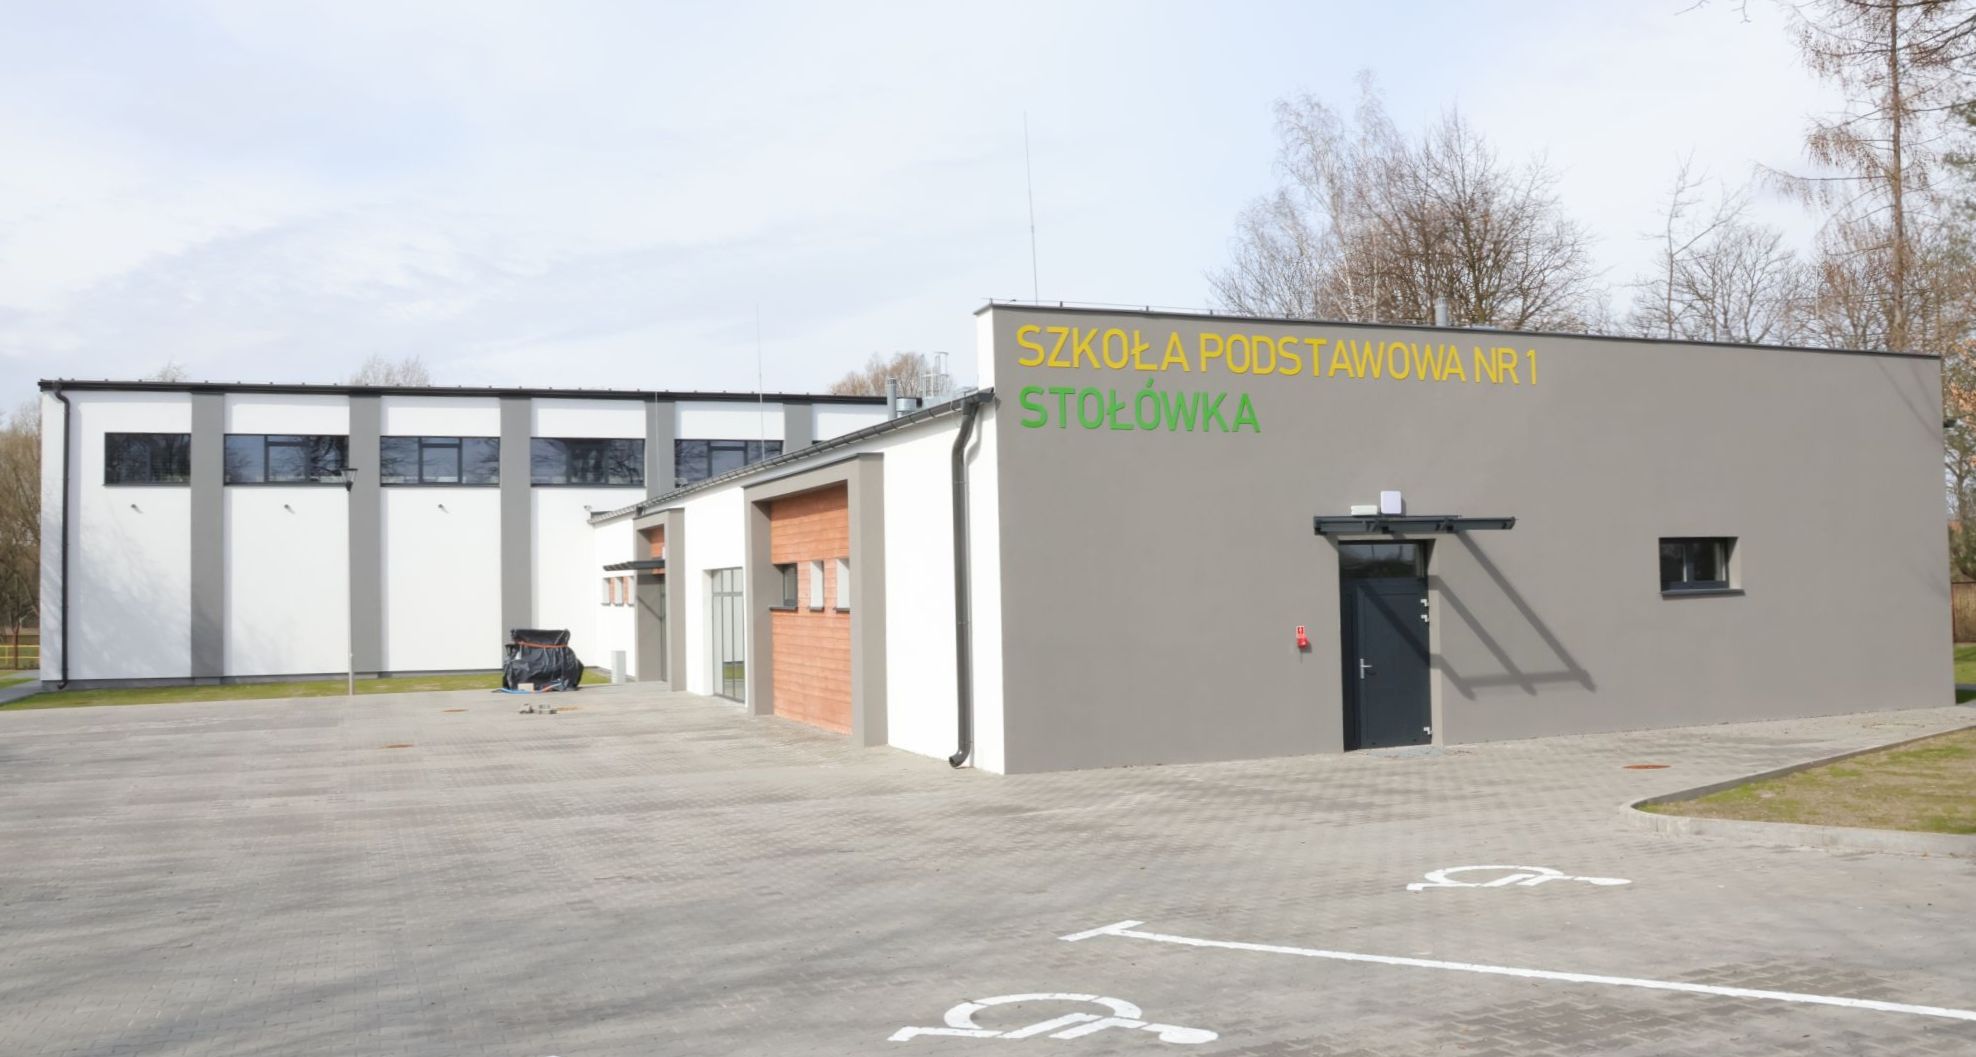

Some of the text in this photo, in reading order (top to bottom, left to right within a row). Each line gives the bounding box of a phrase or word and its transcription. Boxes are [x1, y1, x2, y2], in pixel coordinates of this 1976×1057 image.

[1015, 323, 1538, 386] SZKOŁA PODSTAWOWA NR 1
[1019, 378, 1261, 433] STOŁÓWKA
